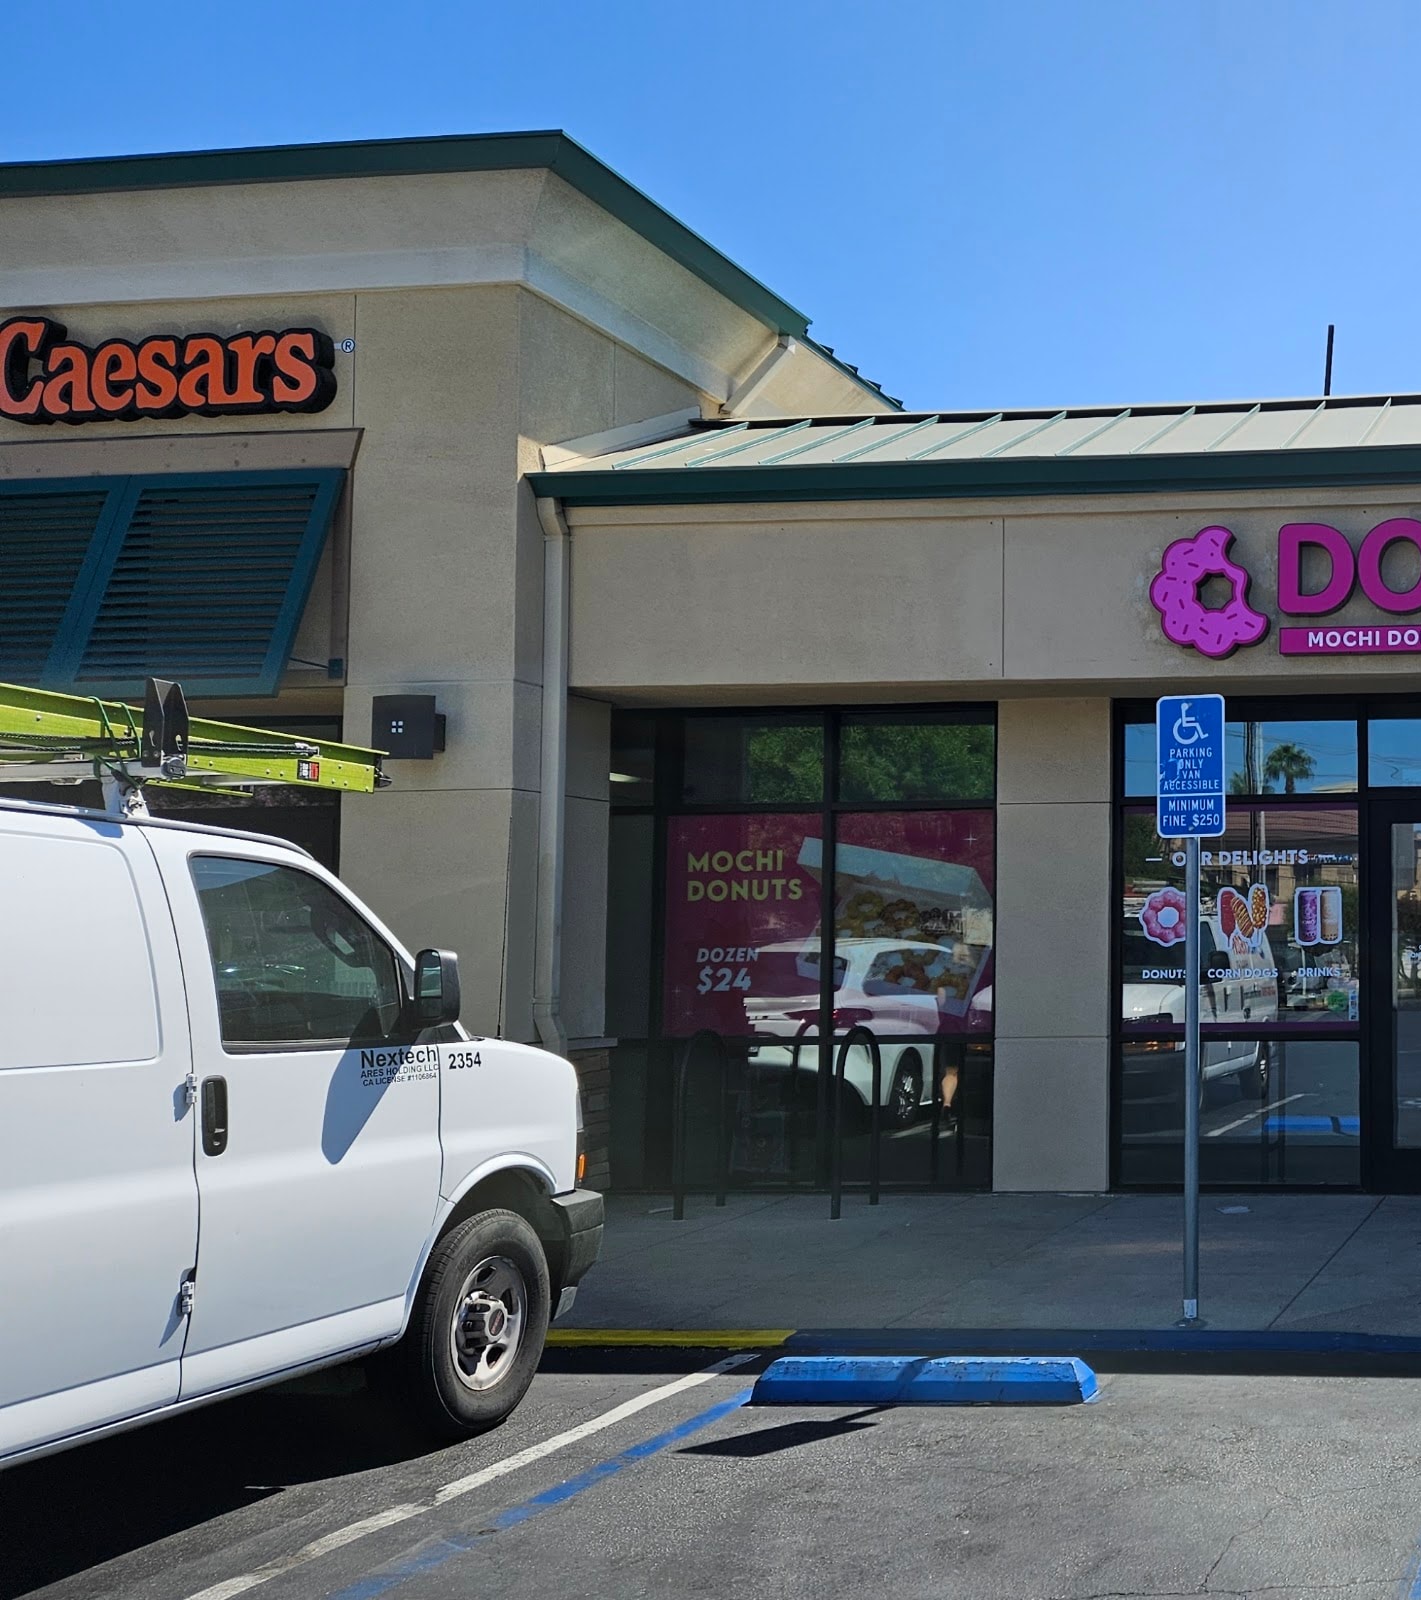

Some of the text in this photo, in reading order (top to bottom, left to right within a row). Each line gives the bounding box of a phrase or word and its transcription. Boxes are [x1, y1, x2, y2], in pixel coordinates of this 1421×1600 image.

[0, 321, 317, 414] Caesars
[1308, 630, 1380, 647] MOCHI
[1169, 747, 1212, 759] PARKING
[1179, 758, 1204, 770] ONLY
[1182, 770, 1200, 779] VAN
[1163, 780, 1220, 791] ACCESSIBLE
[1169, 799, 1214, 812] MINIMUM
[1163, 813, 1220, 827] FINE $250
[687, 850, 783, 873] MOCHI
[1172, 849, 1308, 867] OR DELIGHTS
[687, 878, 803, 902] DONUTS
[696, 948, 759, 963] DOZEN
[697, 966, 752, 995] $24
[1207, 968, 1241, 979] CORN
[1244, 968, 1279, 978] DOGS
[1298, 967, 1341, 977] DRINKS
[361, 1046, 437, 1069] Nextech
[448, 1052, 482, 1070] 2354
[361, 1063, 439, 1079] ARES HOLDING LLC
[363, 1079, 374, 1087] CA
[375, 1075, 406, 1085] LICENSE
